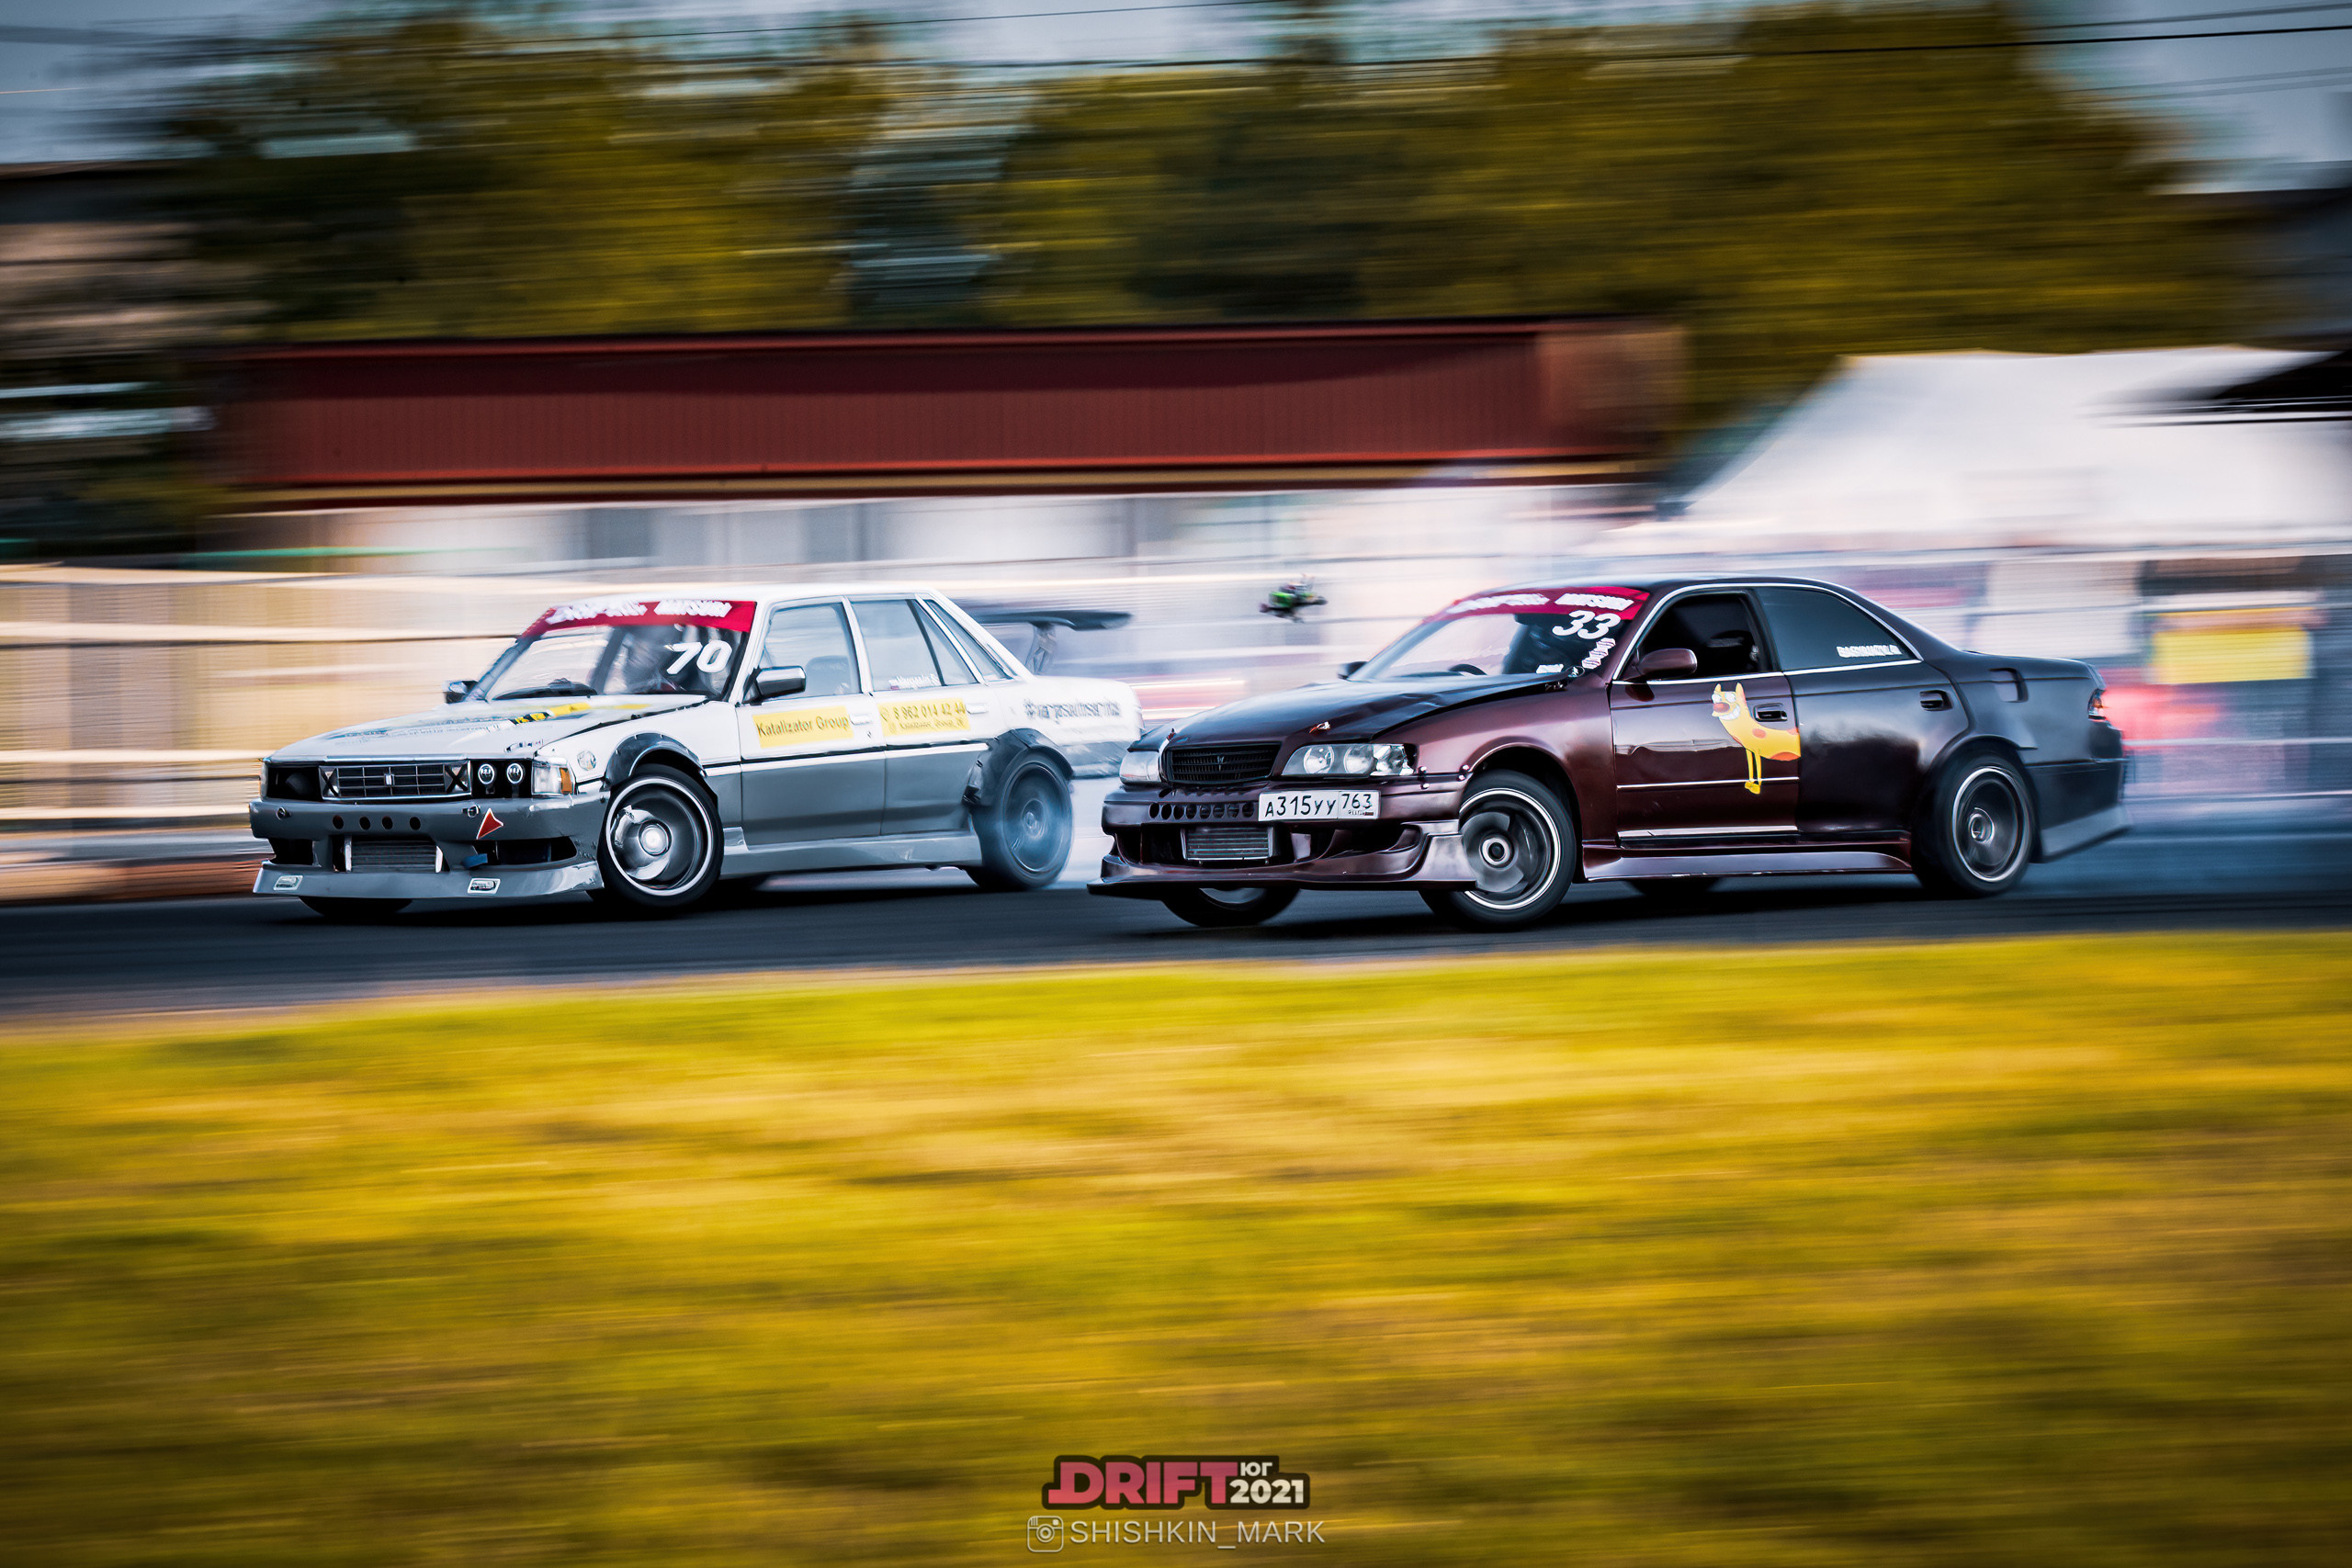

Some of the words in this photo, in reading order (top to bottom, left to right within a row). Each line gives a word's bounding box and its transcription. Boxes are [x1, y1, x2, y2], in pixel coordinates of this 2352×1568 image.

[1552, 610, 1621, 639] 33
[664, 640, 732, 675] 70
[756, 719, 813, 738] Katalizator
[815, 715, 849, 731] Group
[1341, 793, 1373, 809] 763
